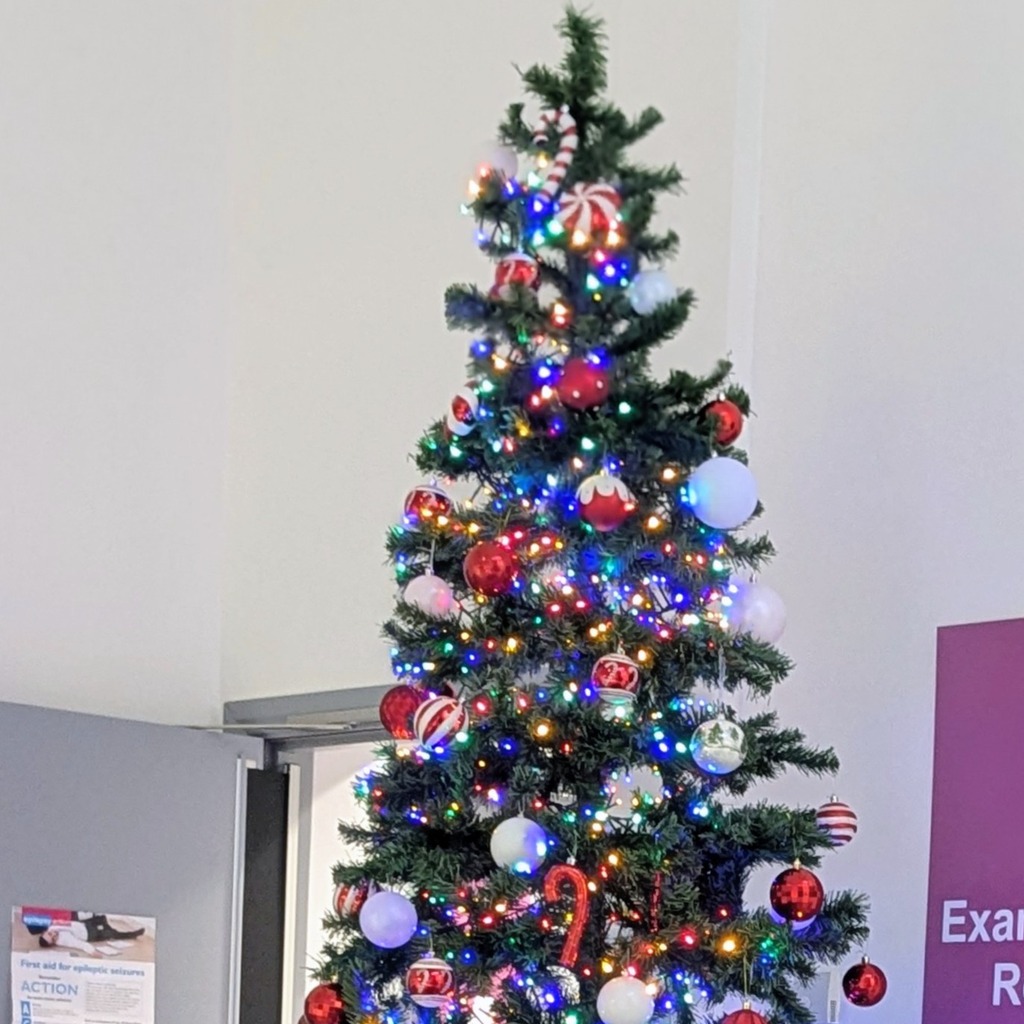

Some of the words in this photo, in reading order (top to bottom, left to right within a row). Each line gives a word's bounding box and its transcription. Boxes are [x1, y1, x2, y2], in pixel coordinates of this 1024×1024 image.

[20, 959, 40, 968] First
[42, 962, 56, 970] aid
[59, 962, 71, 970] for
[73, 964, 108, 975] epileptic
[111, 967, 145, 977] seizures
[21, 980, 79, 996] ACTION
